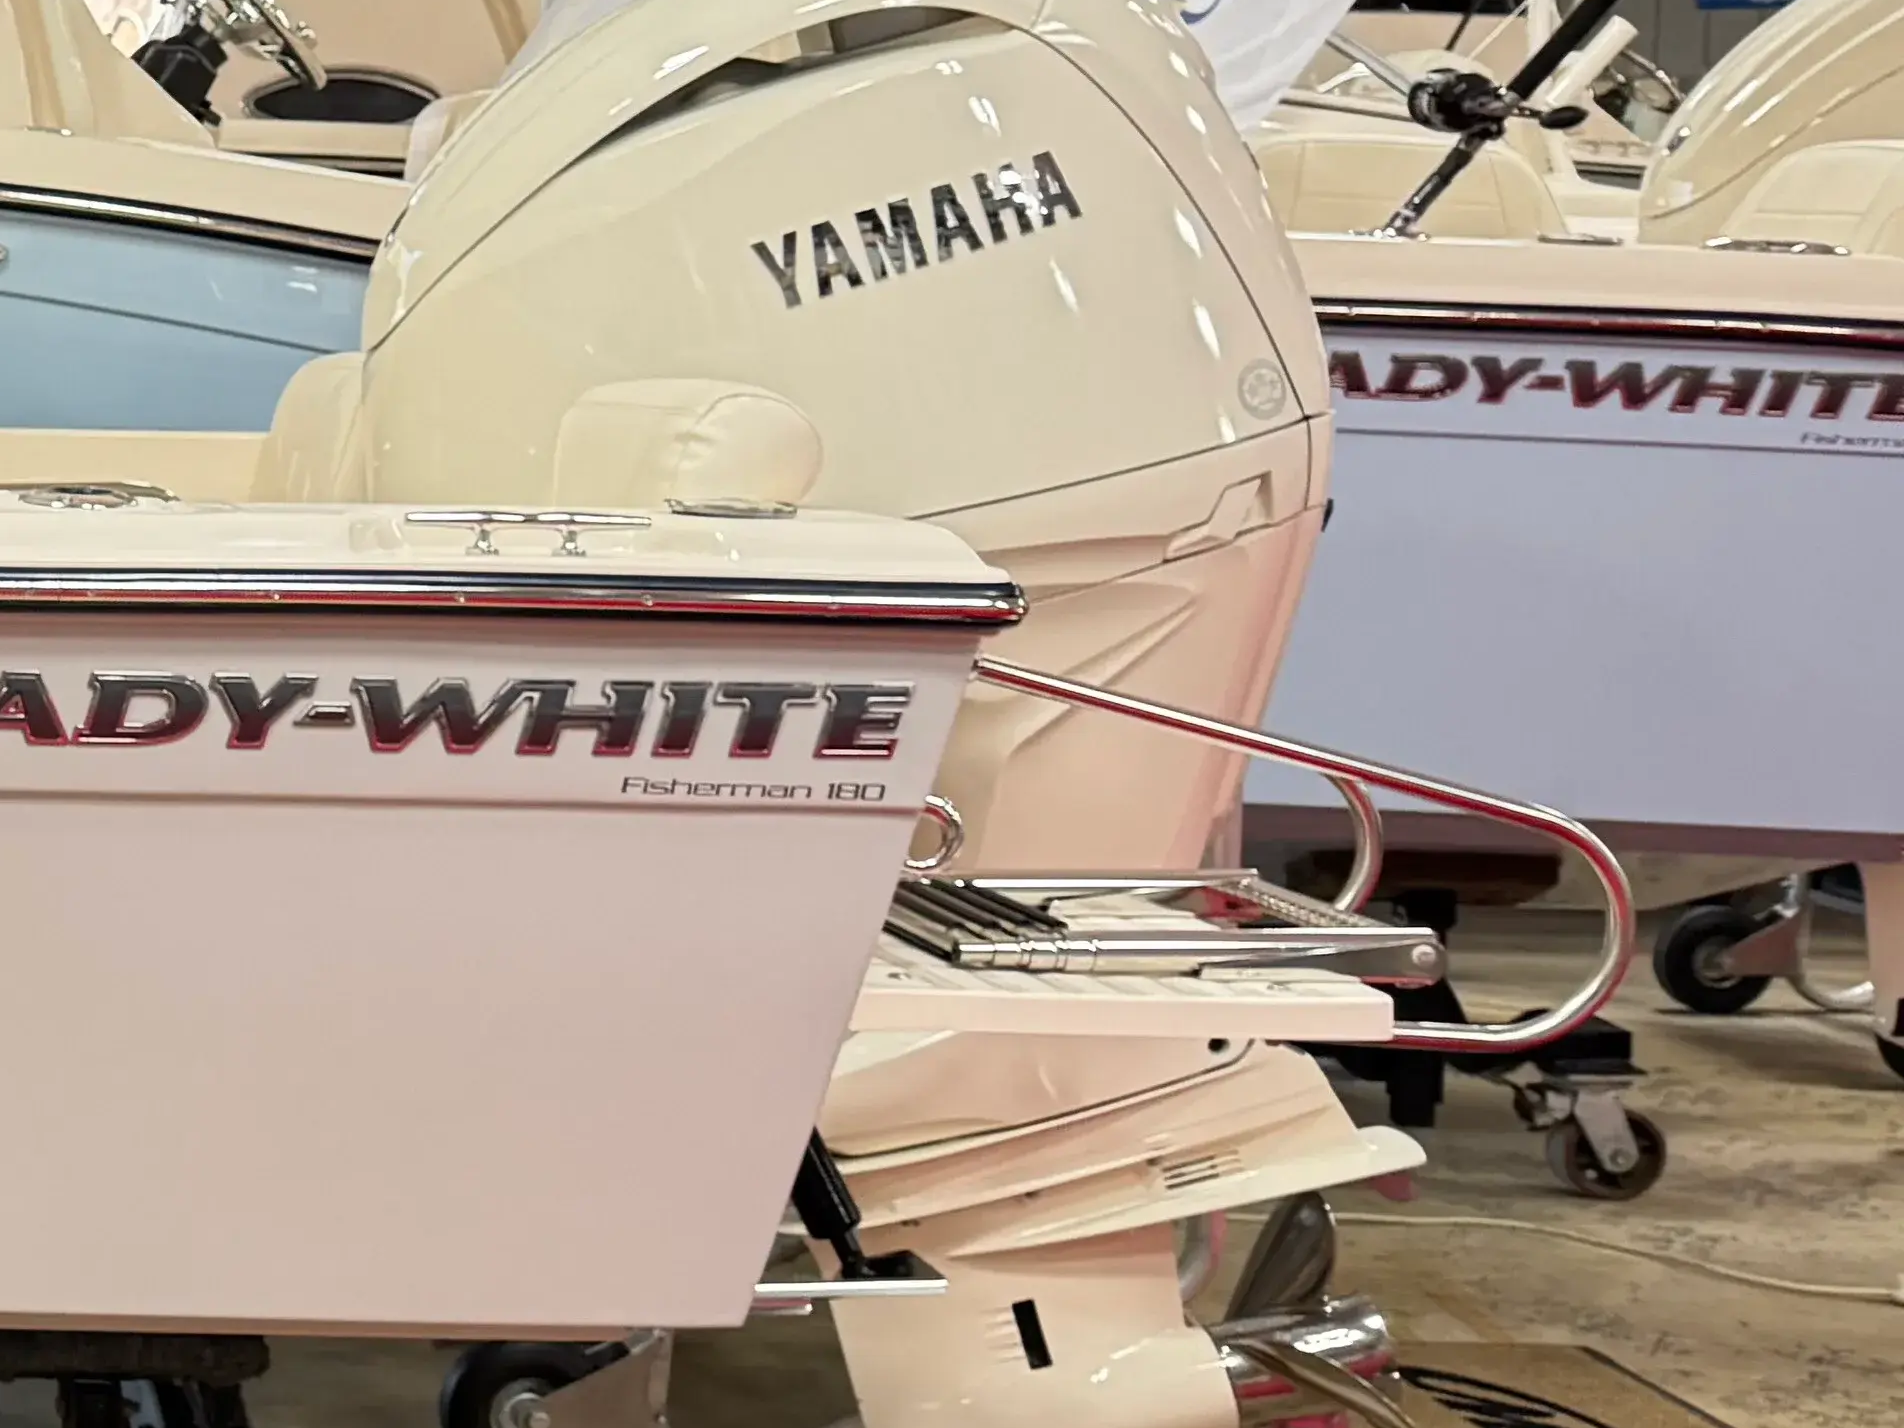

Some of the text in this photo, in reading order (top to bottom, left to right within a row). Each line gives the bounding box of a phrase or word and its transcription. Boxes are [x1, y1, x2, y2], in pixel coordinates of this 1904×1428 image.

[750, 150, 1083, 309] YAMAHA
[620, 776, 887, 802] Fisherman 180
